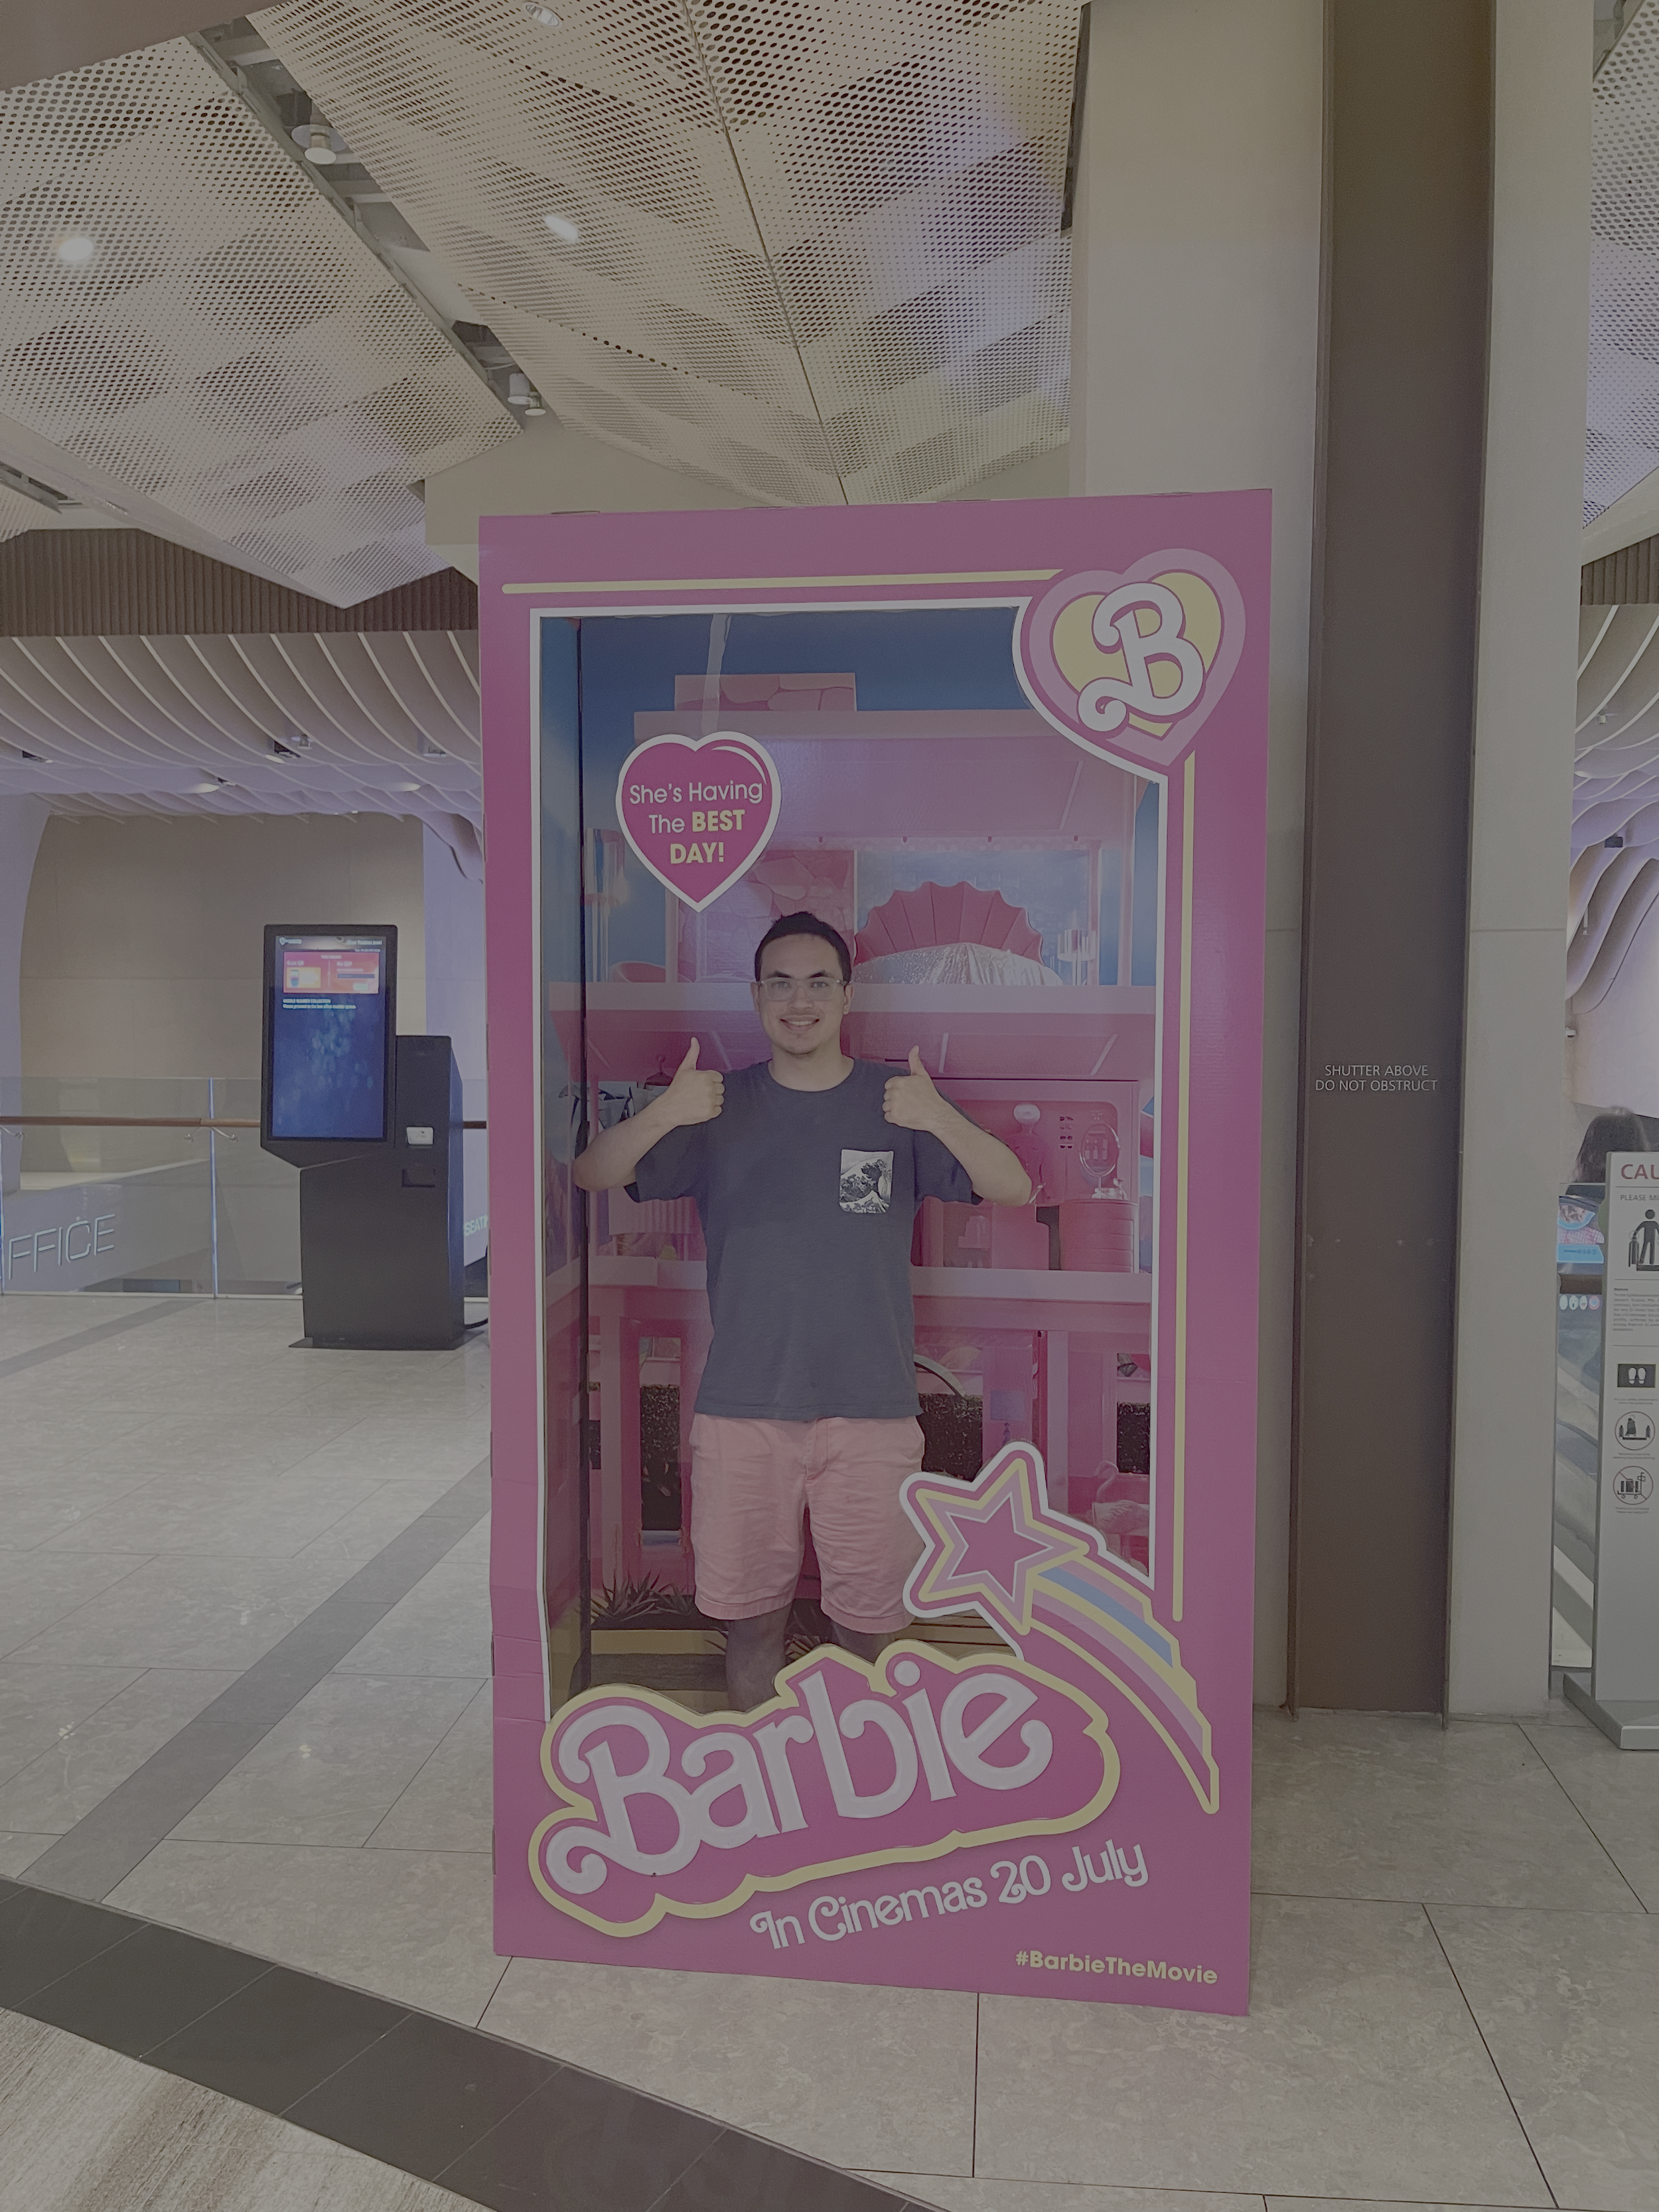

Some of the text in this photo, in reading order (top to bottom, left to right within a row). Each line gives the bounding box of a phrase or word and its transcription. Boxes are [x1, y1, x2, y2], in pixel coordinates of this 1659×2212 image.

[1078, 582, 1204, 732] B
[630, 780, 762, 804] She's Having
[648, 809, 745, 834] The BEST
[670, 842, 724, 864] DAY!
[1325, 1065, 1429, 1076] SHUTTER ABOVE
[1315, 1080, 1437, 1091] DO NOT OBSTRUCT
[0, 1214, 115, 1280] FFICE
[545, 1660, 1053, 1895] Barbie
[750, 1838, 1149, 1949] In Cinemas 20 July
[1015, 1950, 1218, 1984] #BarbieTheMovie
